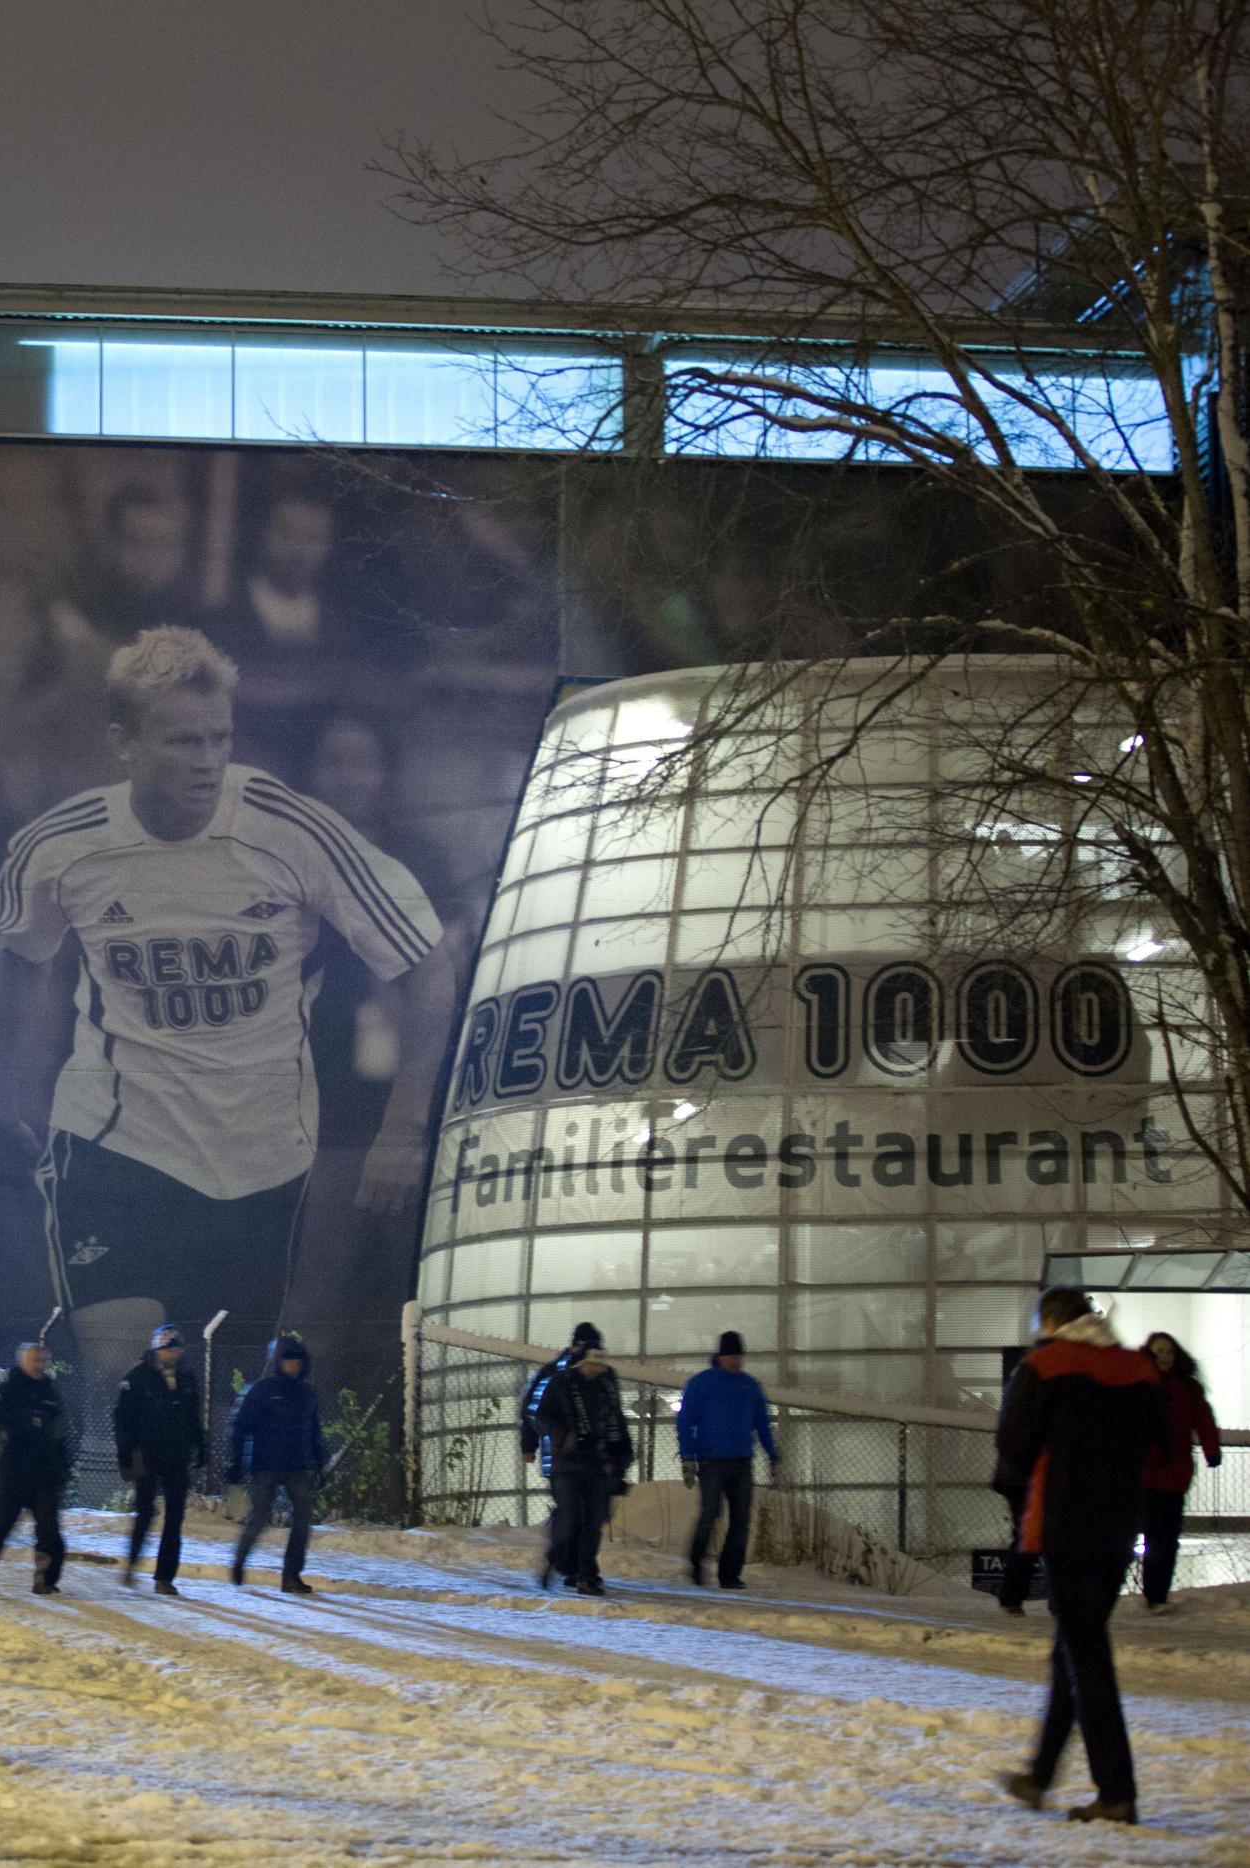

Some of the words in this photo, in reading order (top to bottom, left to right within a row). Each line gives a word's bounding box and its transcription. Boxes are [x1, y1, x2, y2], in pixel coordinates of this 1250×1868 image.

[105, 933, 278, 986] REMA
[136, 978, 268, 1030] 1000
[453, 967, 756, 1113] REMA
[794, 959, 1132, 1079] 1000
[452, 1115, 1172, 1213] Familierestaurant
